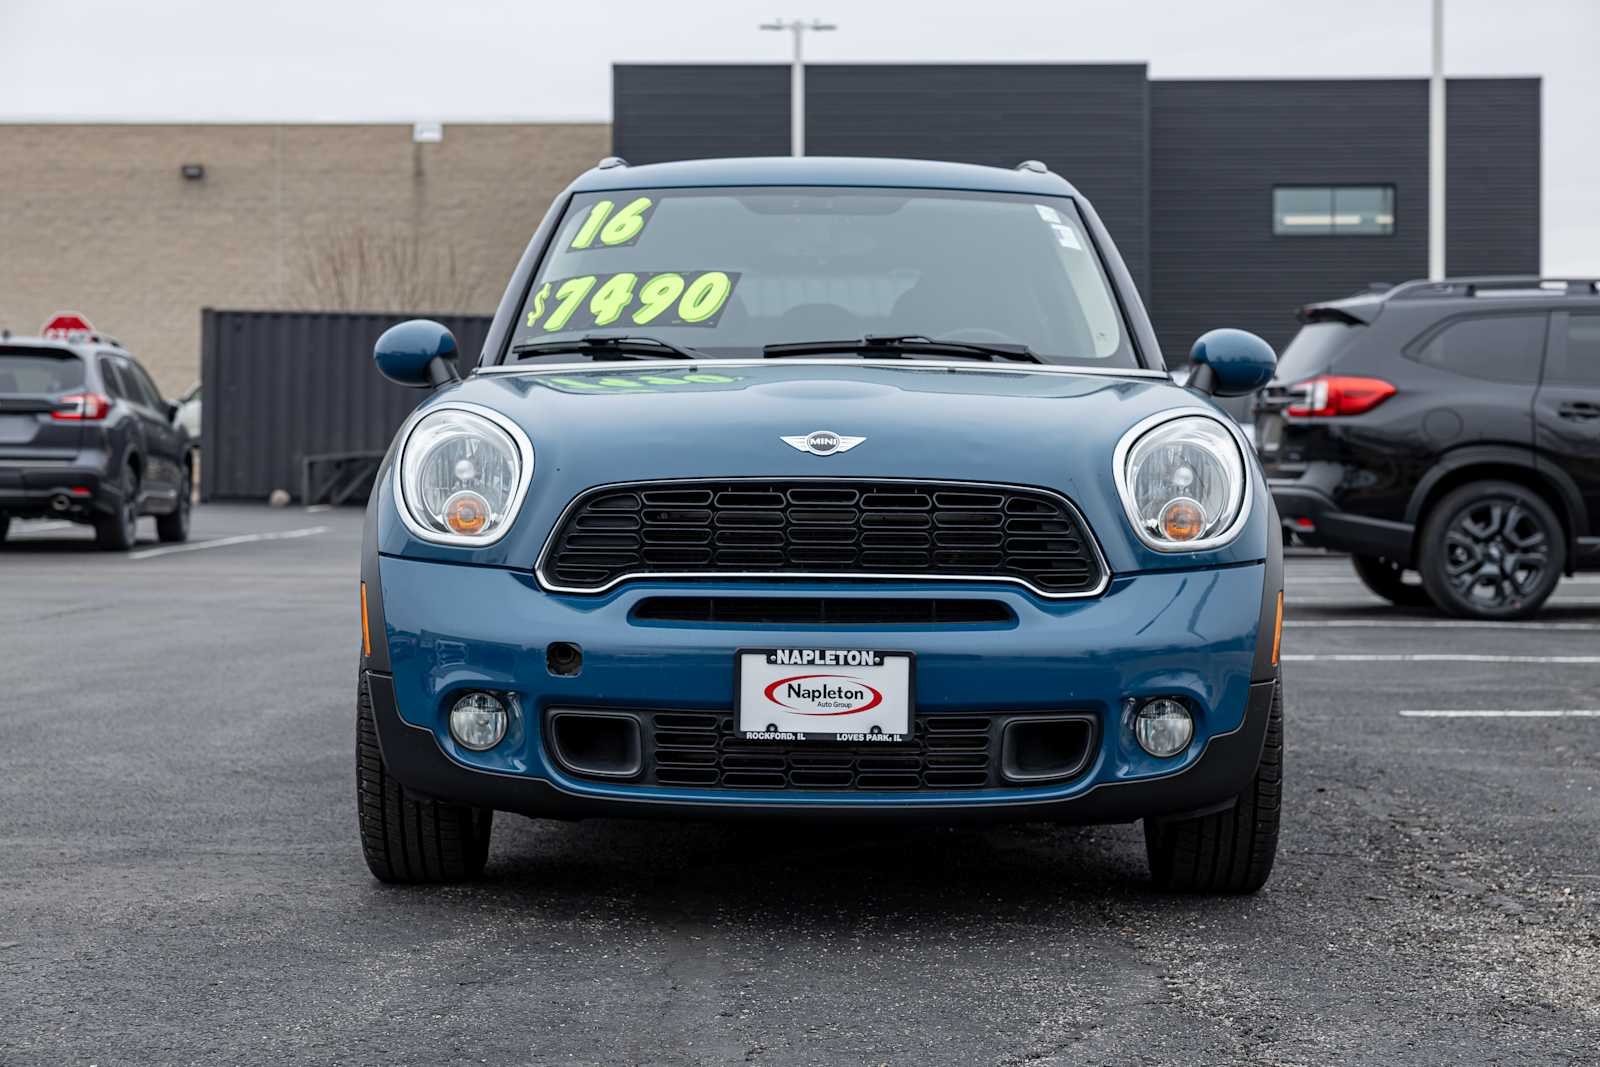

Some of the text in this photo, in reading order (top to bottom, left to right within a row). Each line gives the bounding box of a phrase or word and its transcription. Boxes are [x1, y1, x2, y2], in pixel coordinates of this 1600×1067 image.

[570, 197, 652, 249] 16
[527, 271, 731, 332] $7490
[810, 438, 837, 446] MINI
[776, 649, 874, 666] NAPLETON
[787, 683, 864, 702] Napleton
[833, 701, 852, 709] Group
[746, 731, 806, 741] ROCKFORD, IL
[836, 733, 903, 742] LOVES PARK, IL
